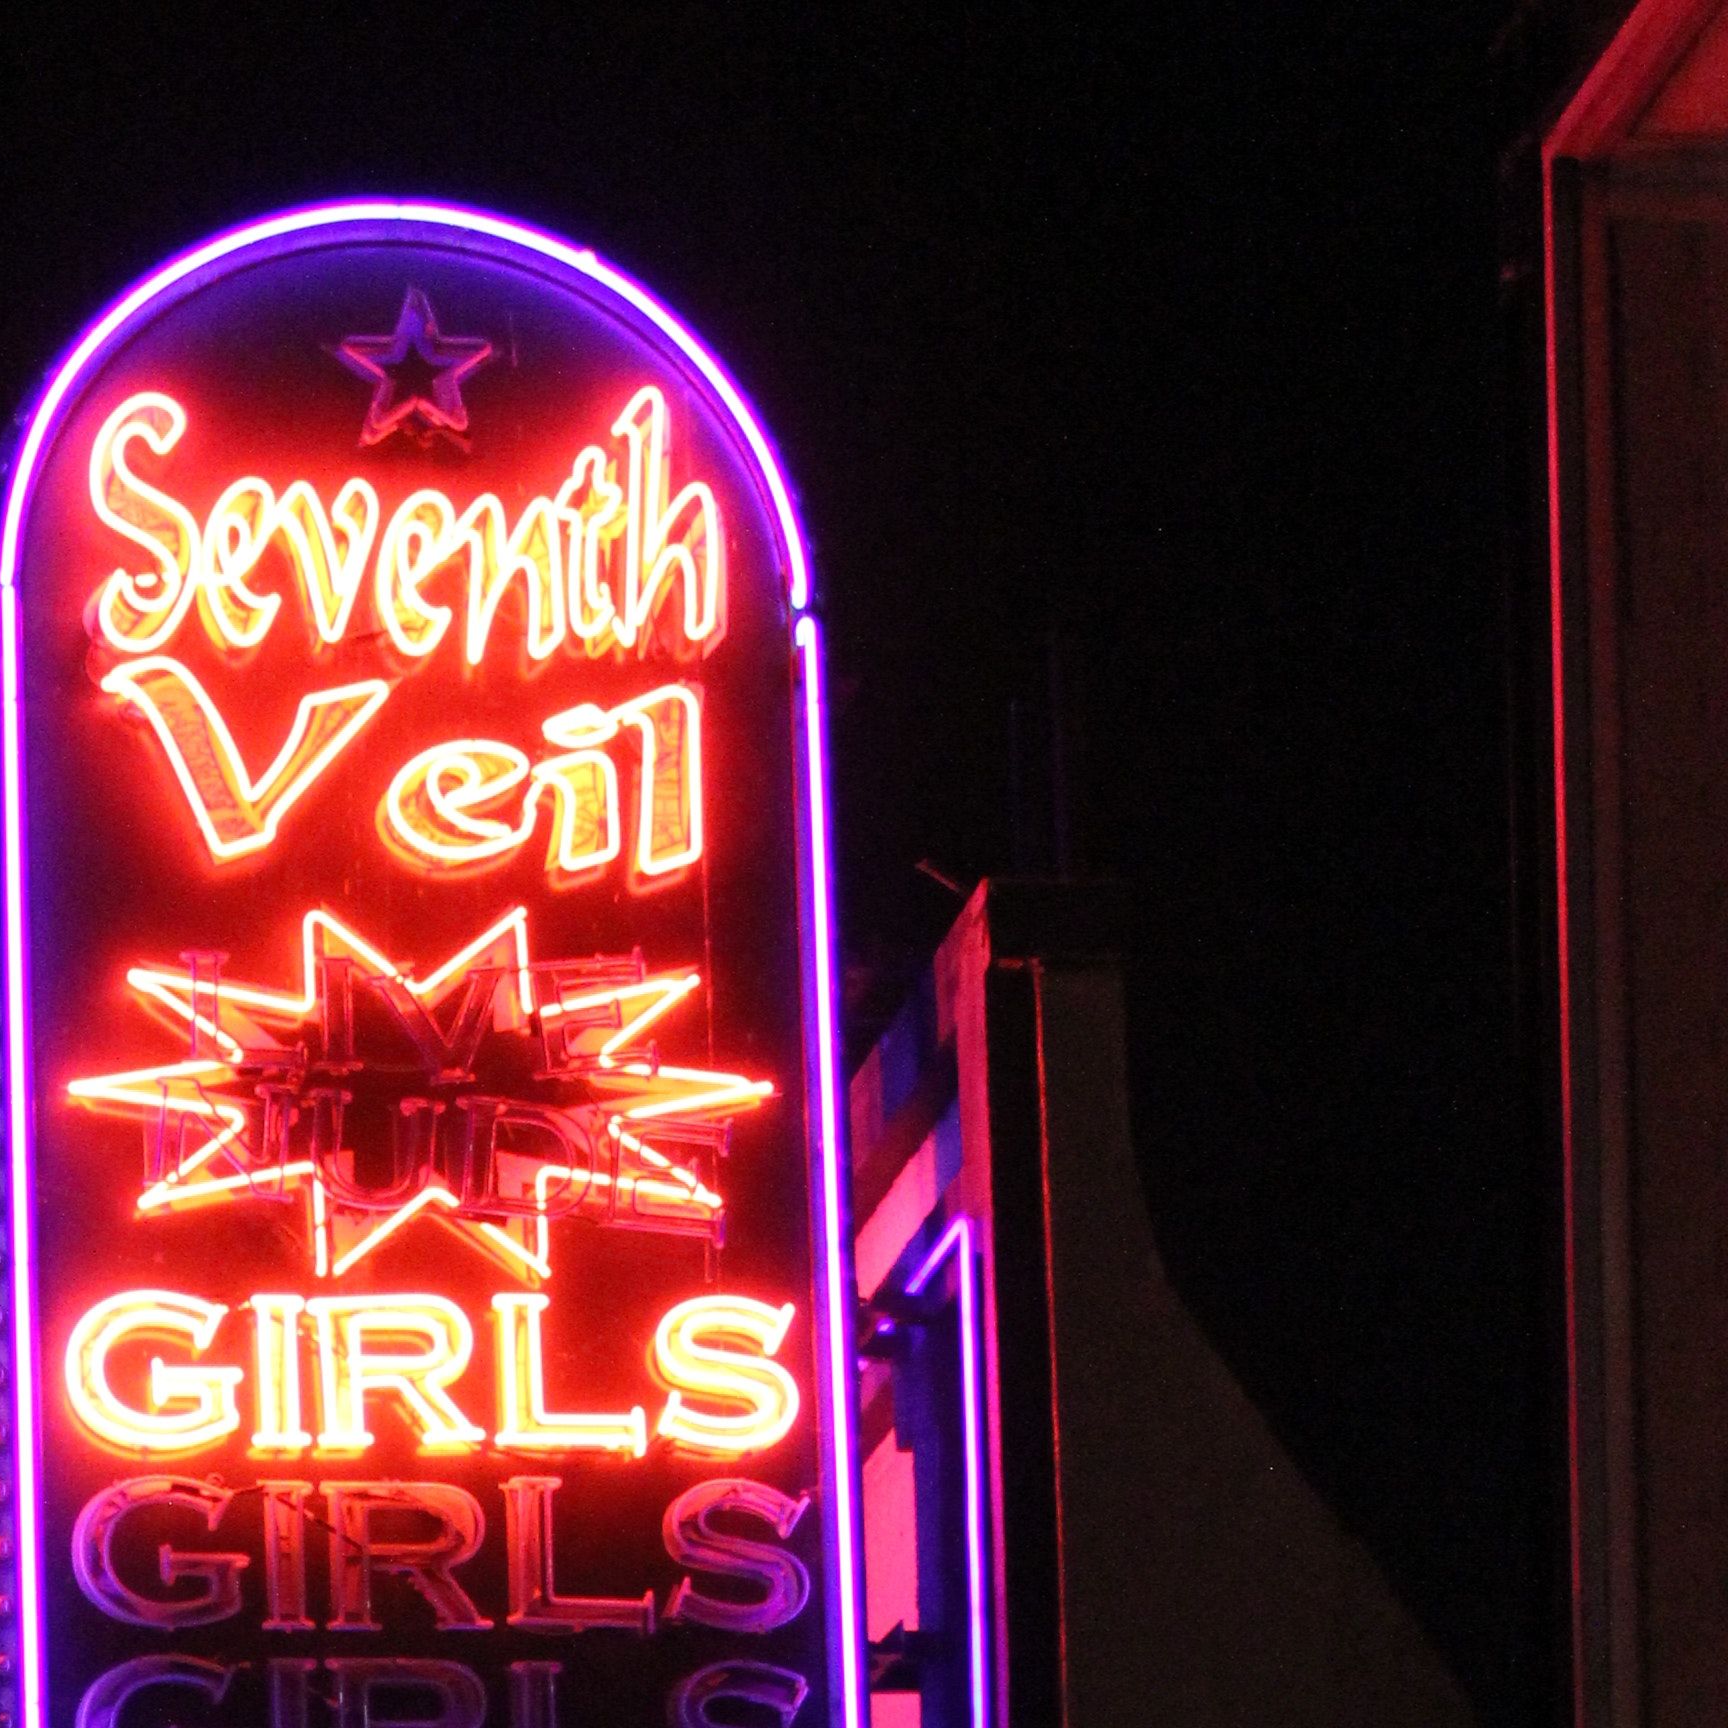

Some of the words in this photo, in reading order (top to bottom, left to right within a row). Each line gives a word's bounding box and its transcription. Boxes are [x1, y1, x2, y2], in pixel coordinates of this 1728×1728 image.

[87, 388, 723, 664] Seventh
[103, 655, 704, 885] Veil
[178, 946, 660, 1083] LIVE
[143, 1074, 733, 1249] NUDE
[65, 1290, 801, 1459] GIRLS
[73, 1474, 811, 1633] GIRLS
